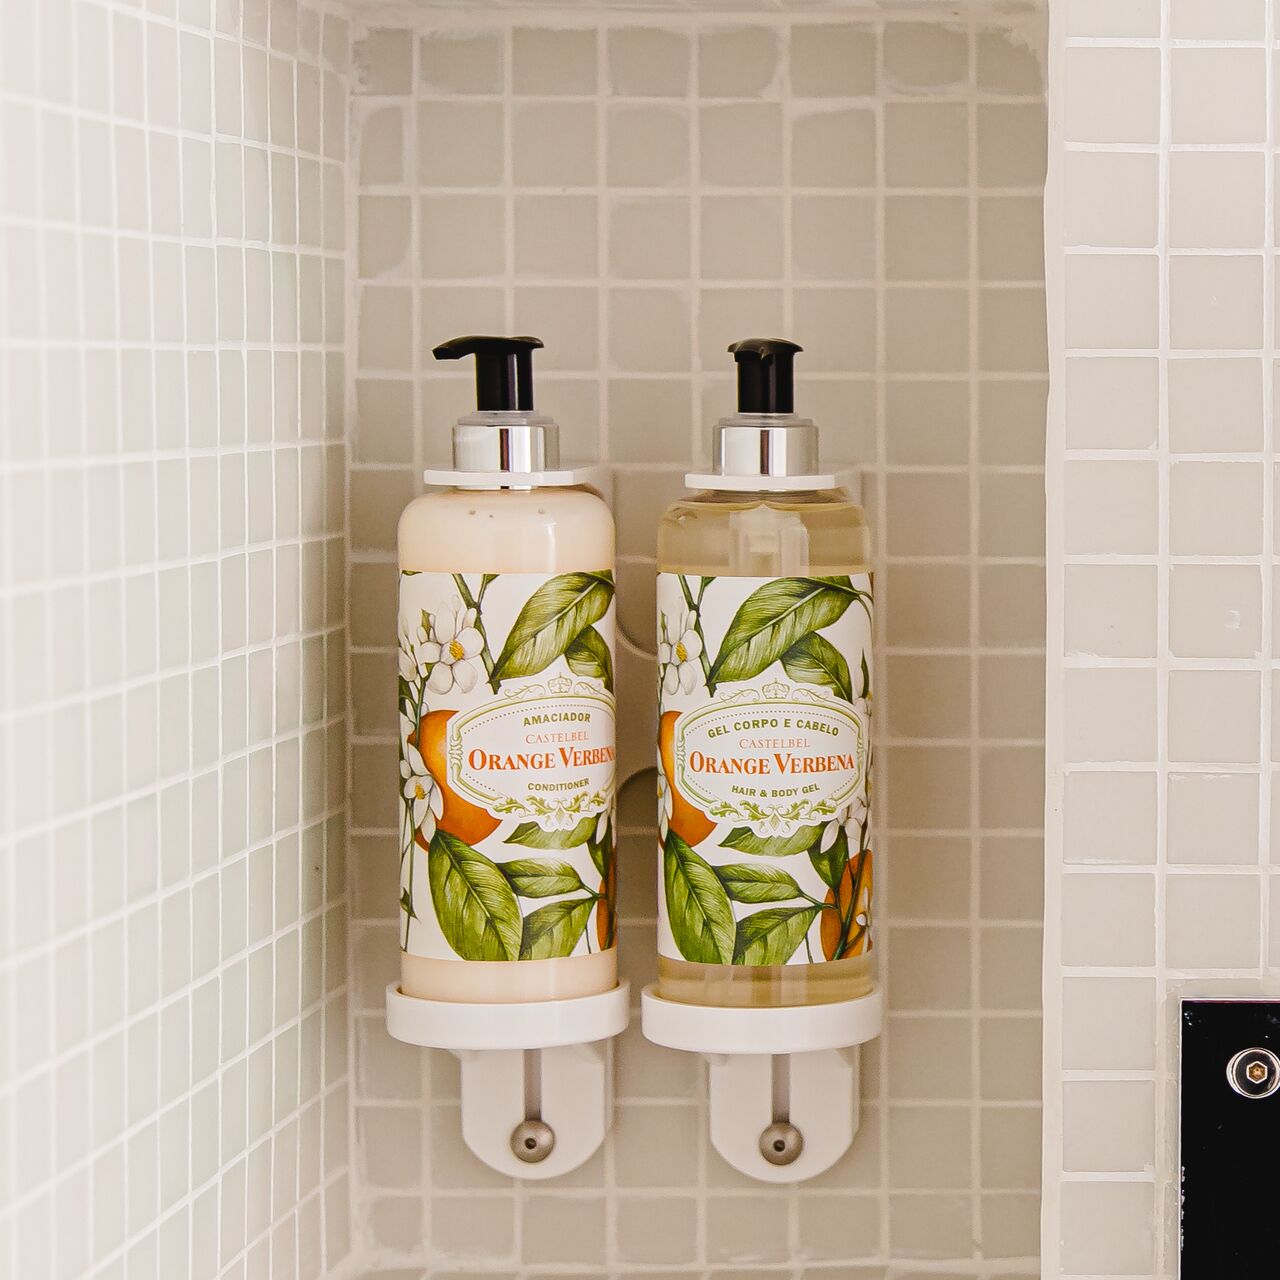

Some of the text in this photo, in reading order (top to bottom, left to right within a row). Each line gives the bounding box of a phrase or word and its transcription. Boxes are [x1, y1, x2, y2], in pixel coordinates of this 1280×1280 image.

[523, 712, 591, 727] AMACIADOR
[707, 718, 840, 739] GEL CORPO E CABELO
[525, 730, 589, 745] CASTELBEL
[738, 738, 811, 749] CASTELBEL
[468, 748, 556, 771] ORANGE
[689, 750, 855, 775] ORANGE VERBENA
[527, 777, 590, 792] CONDITIONER
[731, 783, 821, 798] HAIR & BODY GEL
